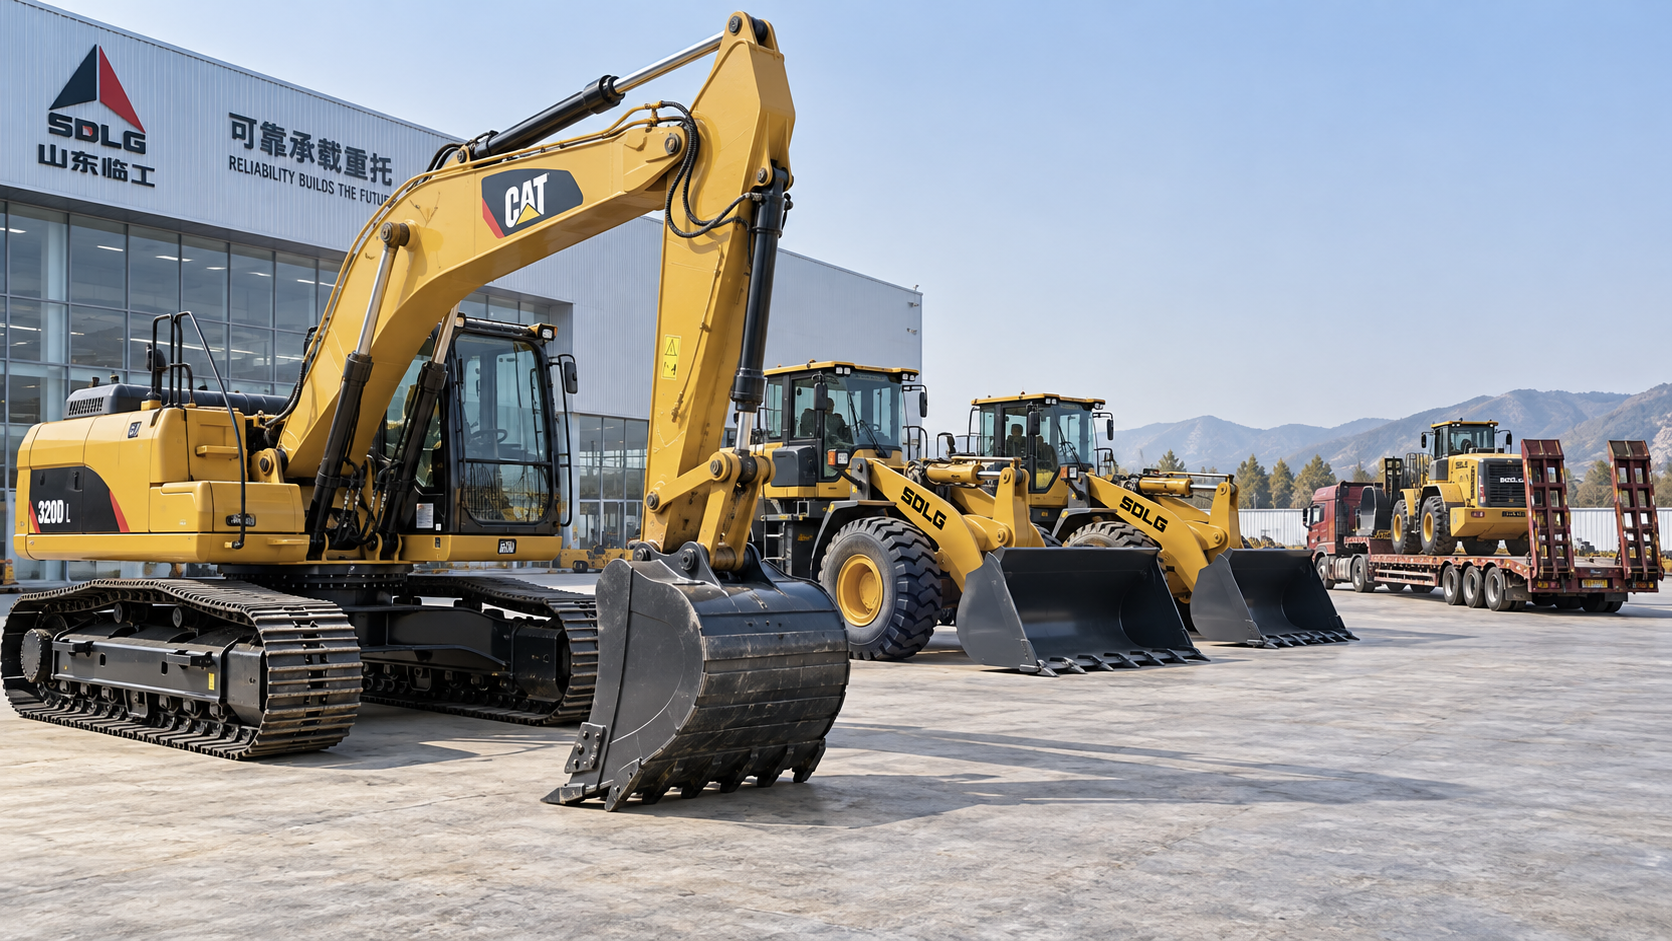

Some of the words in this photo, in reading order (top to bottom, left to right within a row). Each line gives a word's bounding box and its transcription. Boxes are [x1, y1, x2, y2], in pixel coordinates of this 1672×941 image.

[48, 112, 146, 155] SDLG
[228, 112, 393, 187] 可靠承载重托
[38, 143, 155, 188] 山东临工
[229, 155, 296, 185] RELIABILITY
[299, 172, 335, 195] BUILDS
[338, 183, 357, 200] THE
[505, 172, 548, 228] CAT
[37, 499, 64, 524] 320D
[66, 503, 71, 523] L
[900, 486, 947, 531] SDLG
[1119, 495, 1169, 533] SDLG
